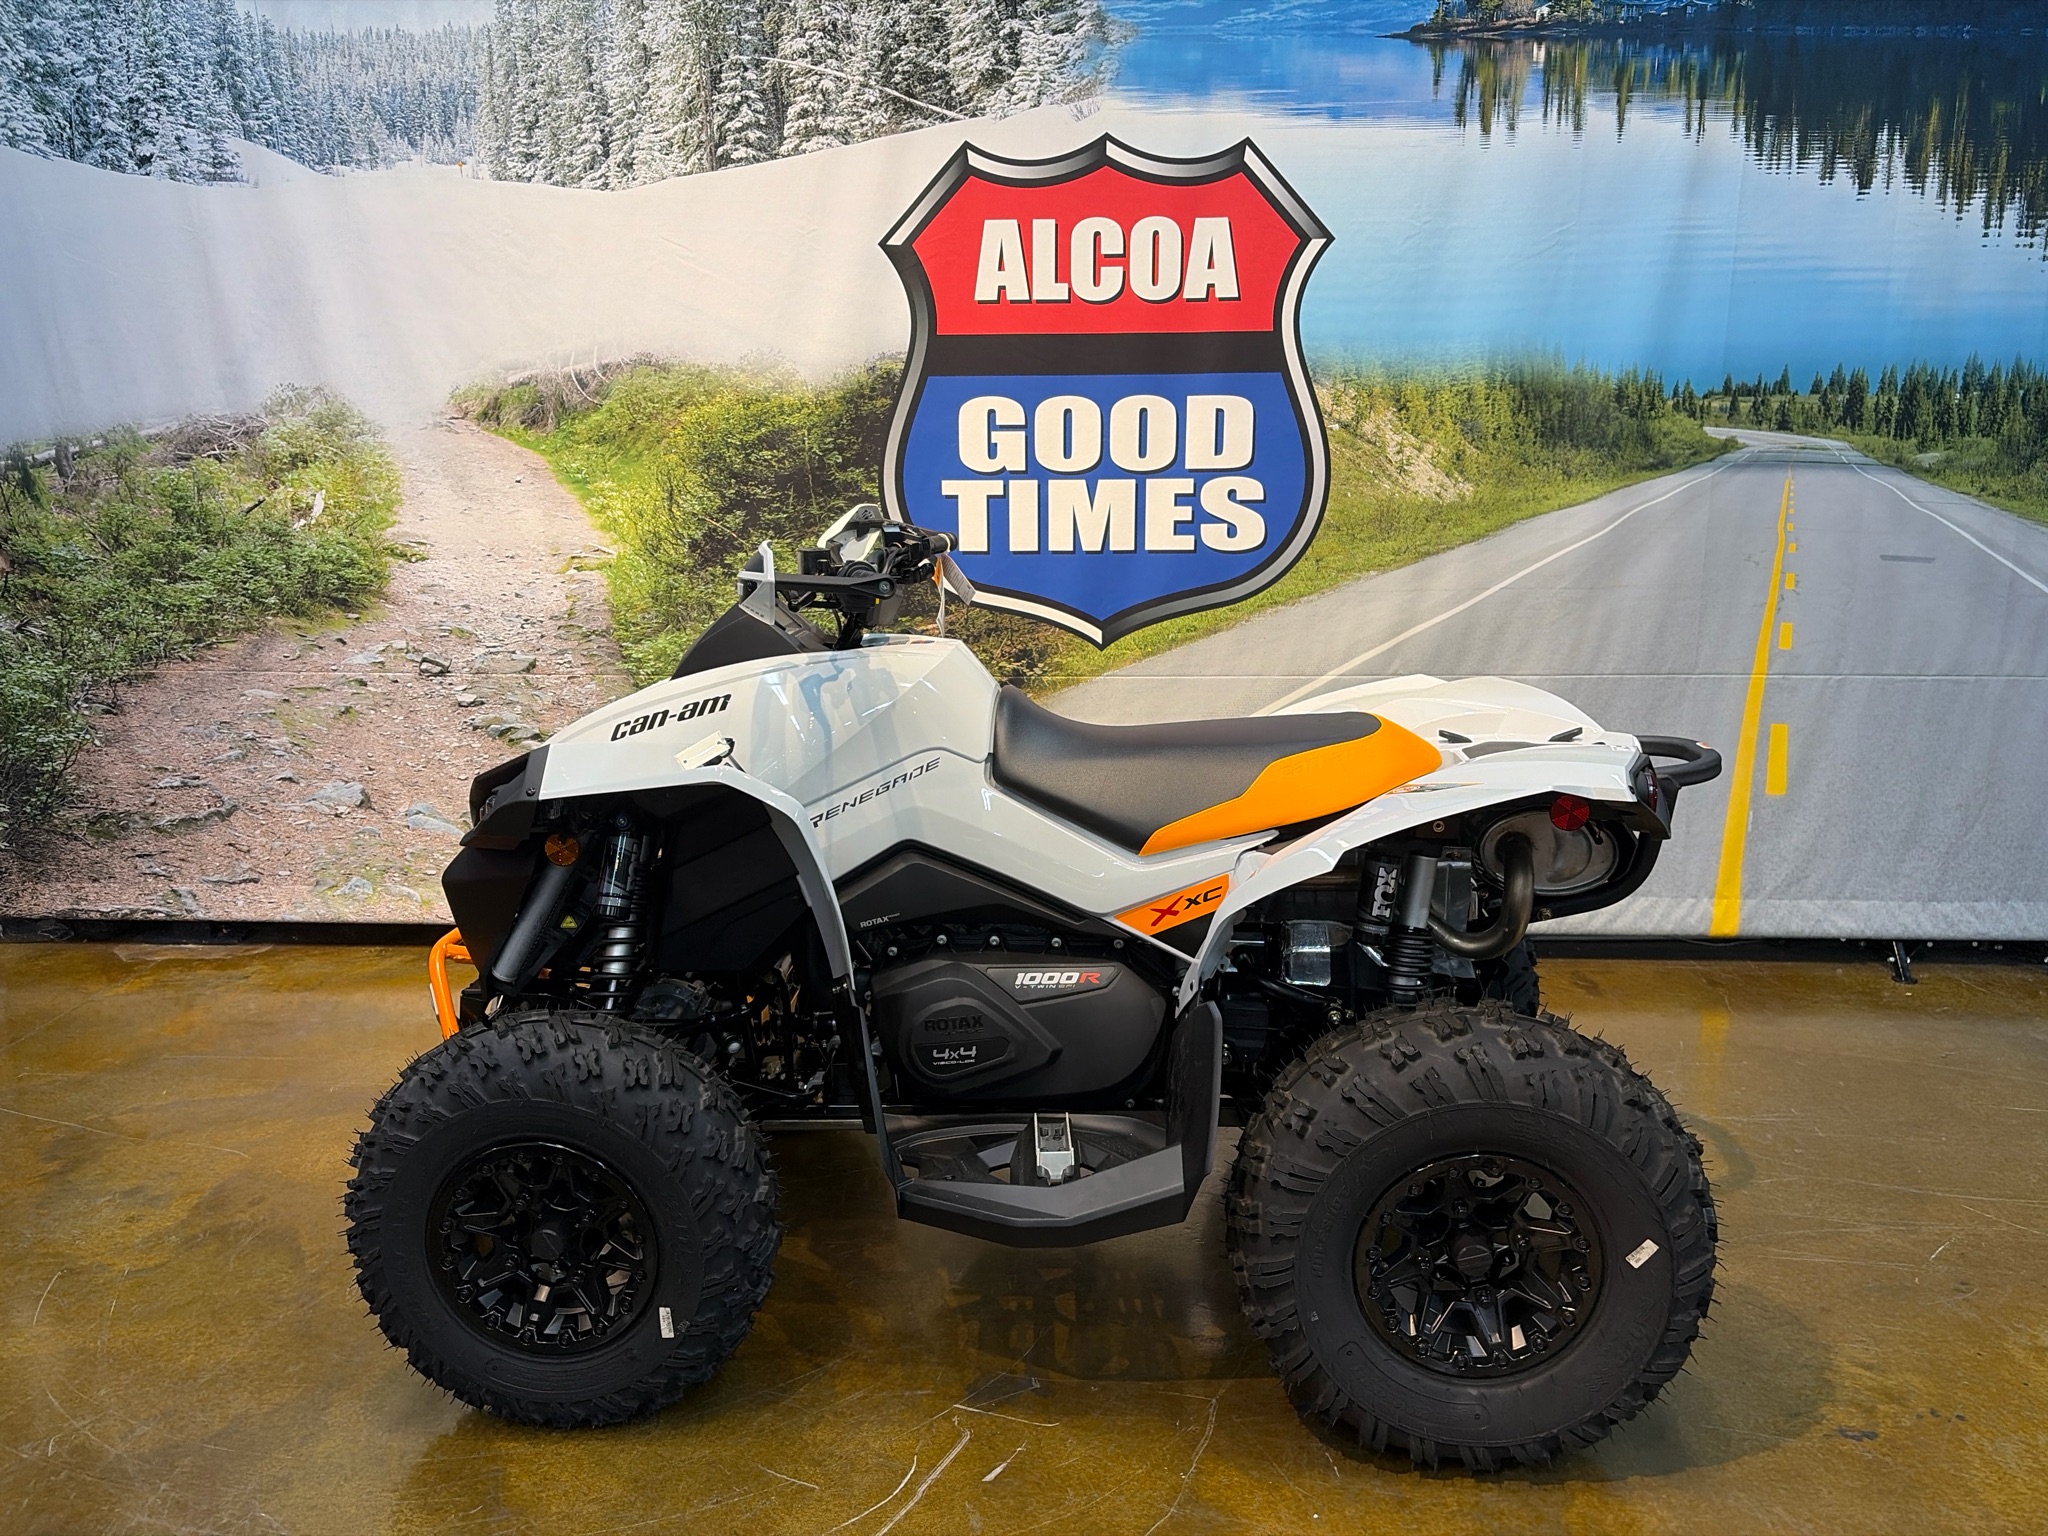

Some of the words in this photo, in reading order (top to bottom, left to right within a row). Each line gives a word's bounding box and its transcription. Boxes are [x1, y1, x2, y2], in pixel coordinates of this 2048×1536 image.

[974, 216, 1241, 303] ALCOA
[958, 395, 1255, 473] GOOD
[941, 476, 1266, 553] TIMES
[610, 693, 732, 742] can-am
[809, 757, 941, 829] RENEGADE
[1371, 867, 1397, 918] FOX
[860, 916, 889, 929] ROTAX
[1014, 972, 1101, 984] 1000R
[924, 1014, 984, 1031] ROTAX
